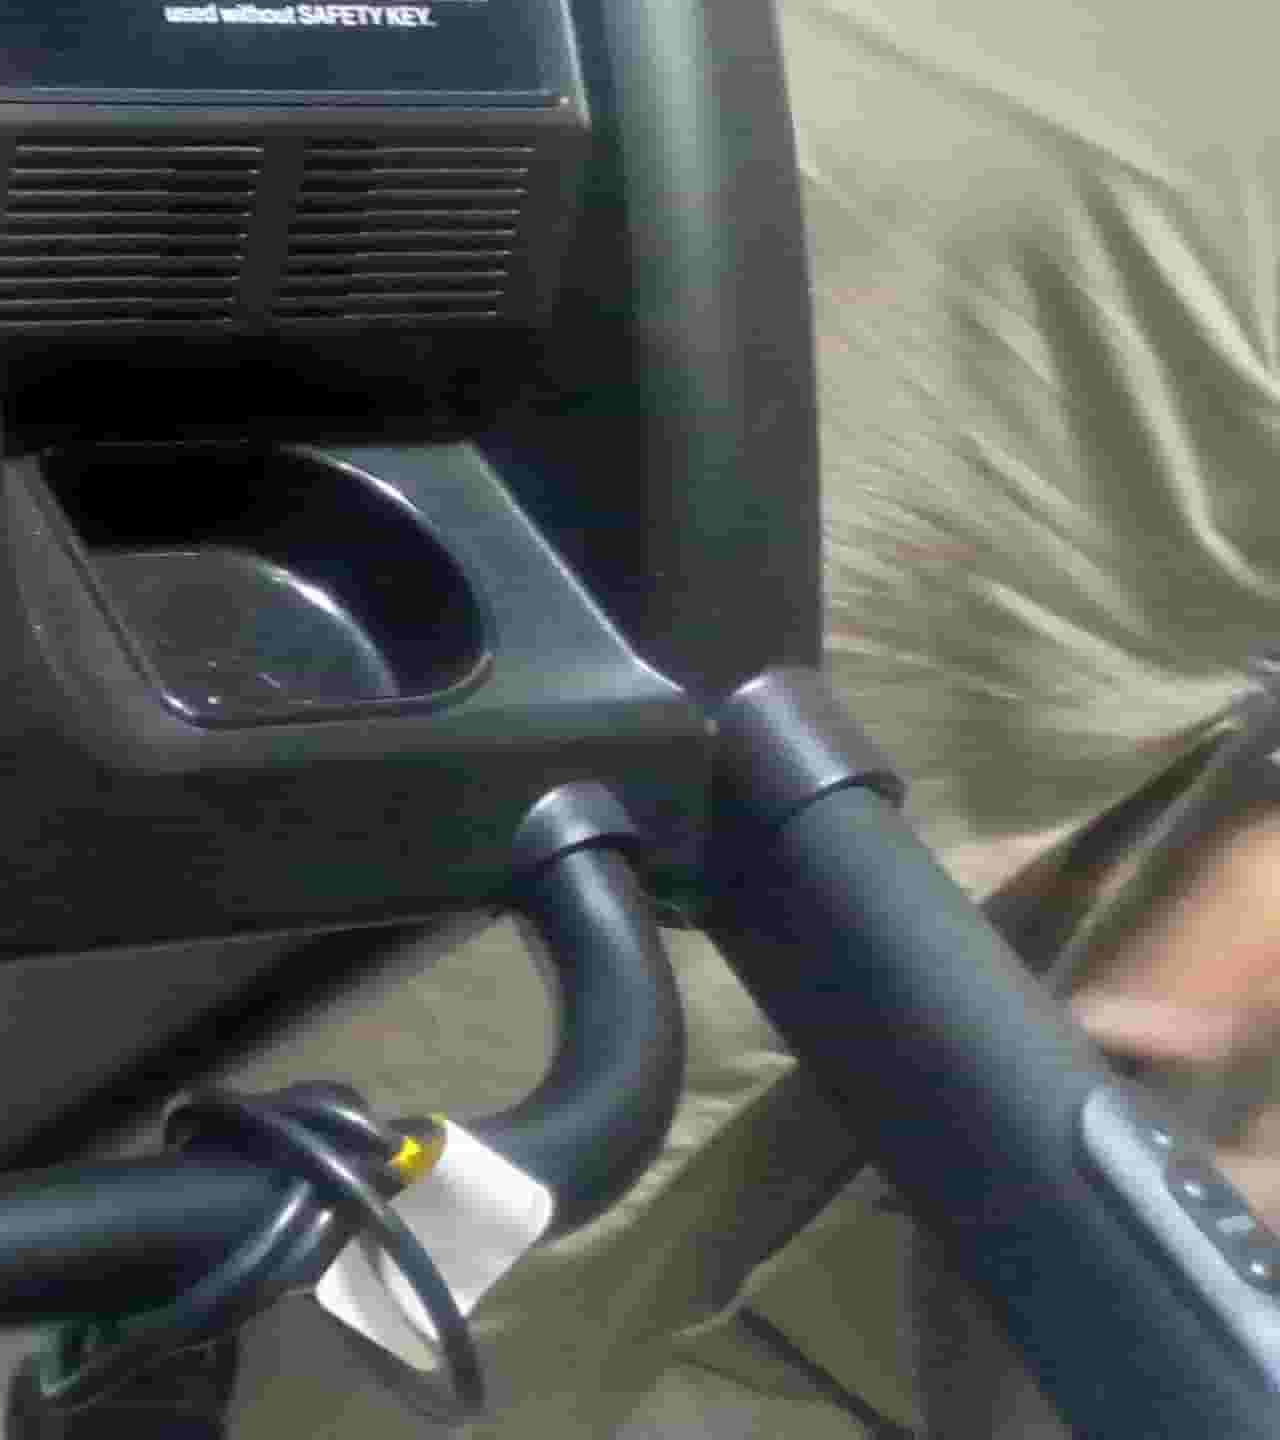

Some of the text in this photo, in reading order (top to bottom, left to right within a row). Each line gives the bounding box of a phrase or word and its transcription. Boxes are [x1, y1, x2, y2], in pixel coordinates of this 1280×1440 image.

[220, 4, 296, 24] without
[299, 5, 385, 25] SAFETY
[387, 6, 437, 27] KEY.
